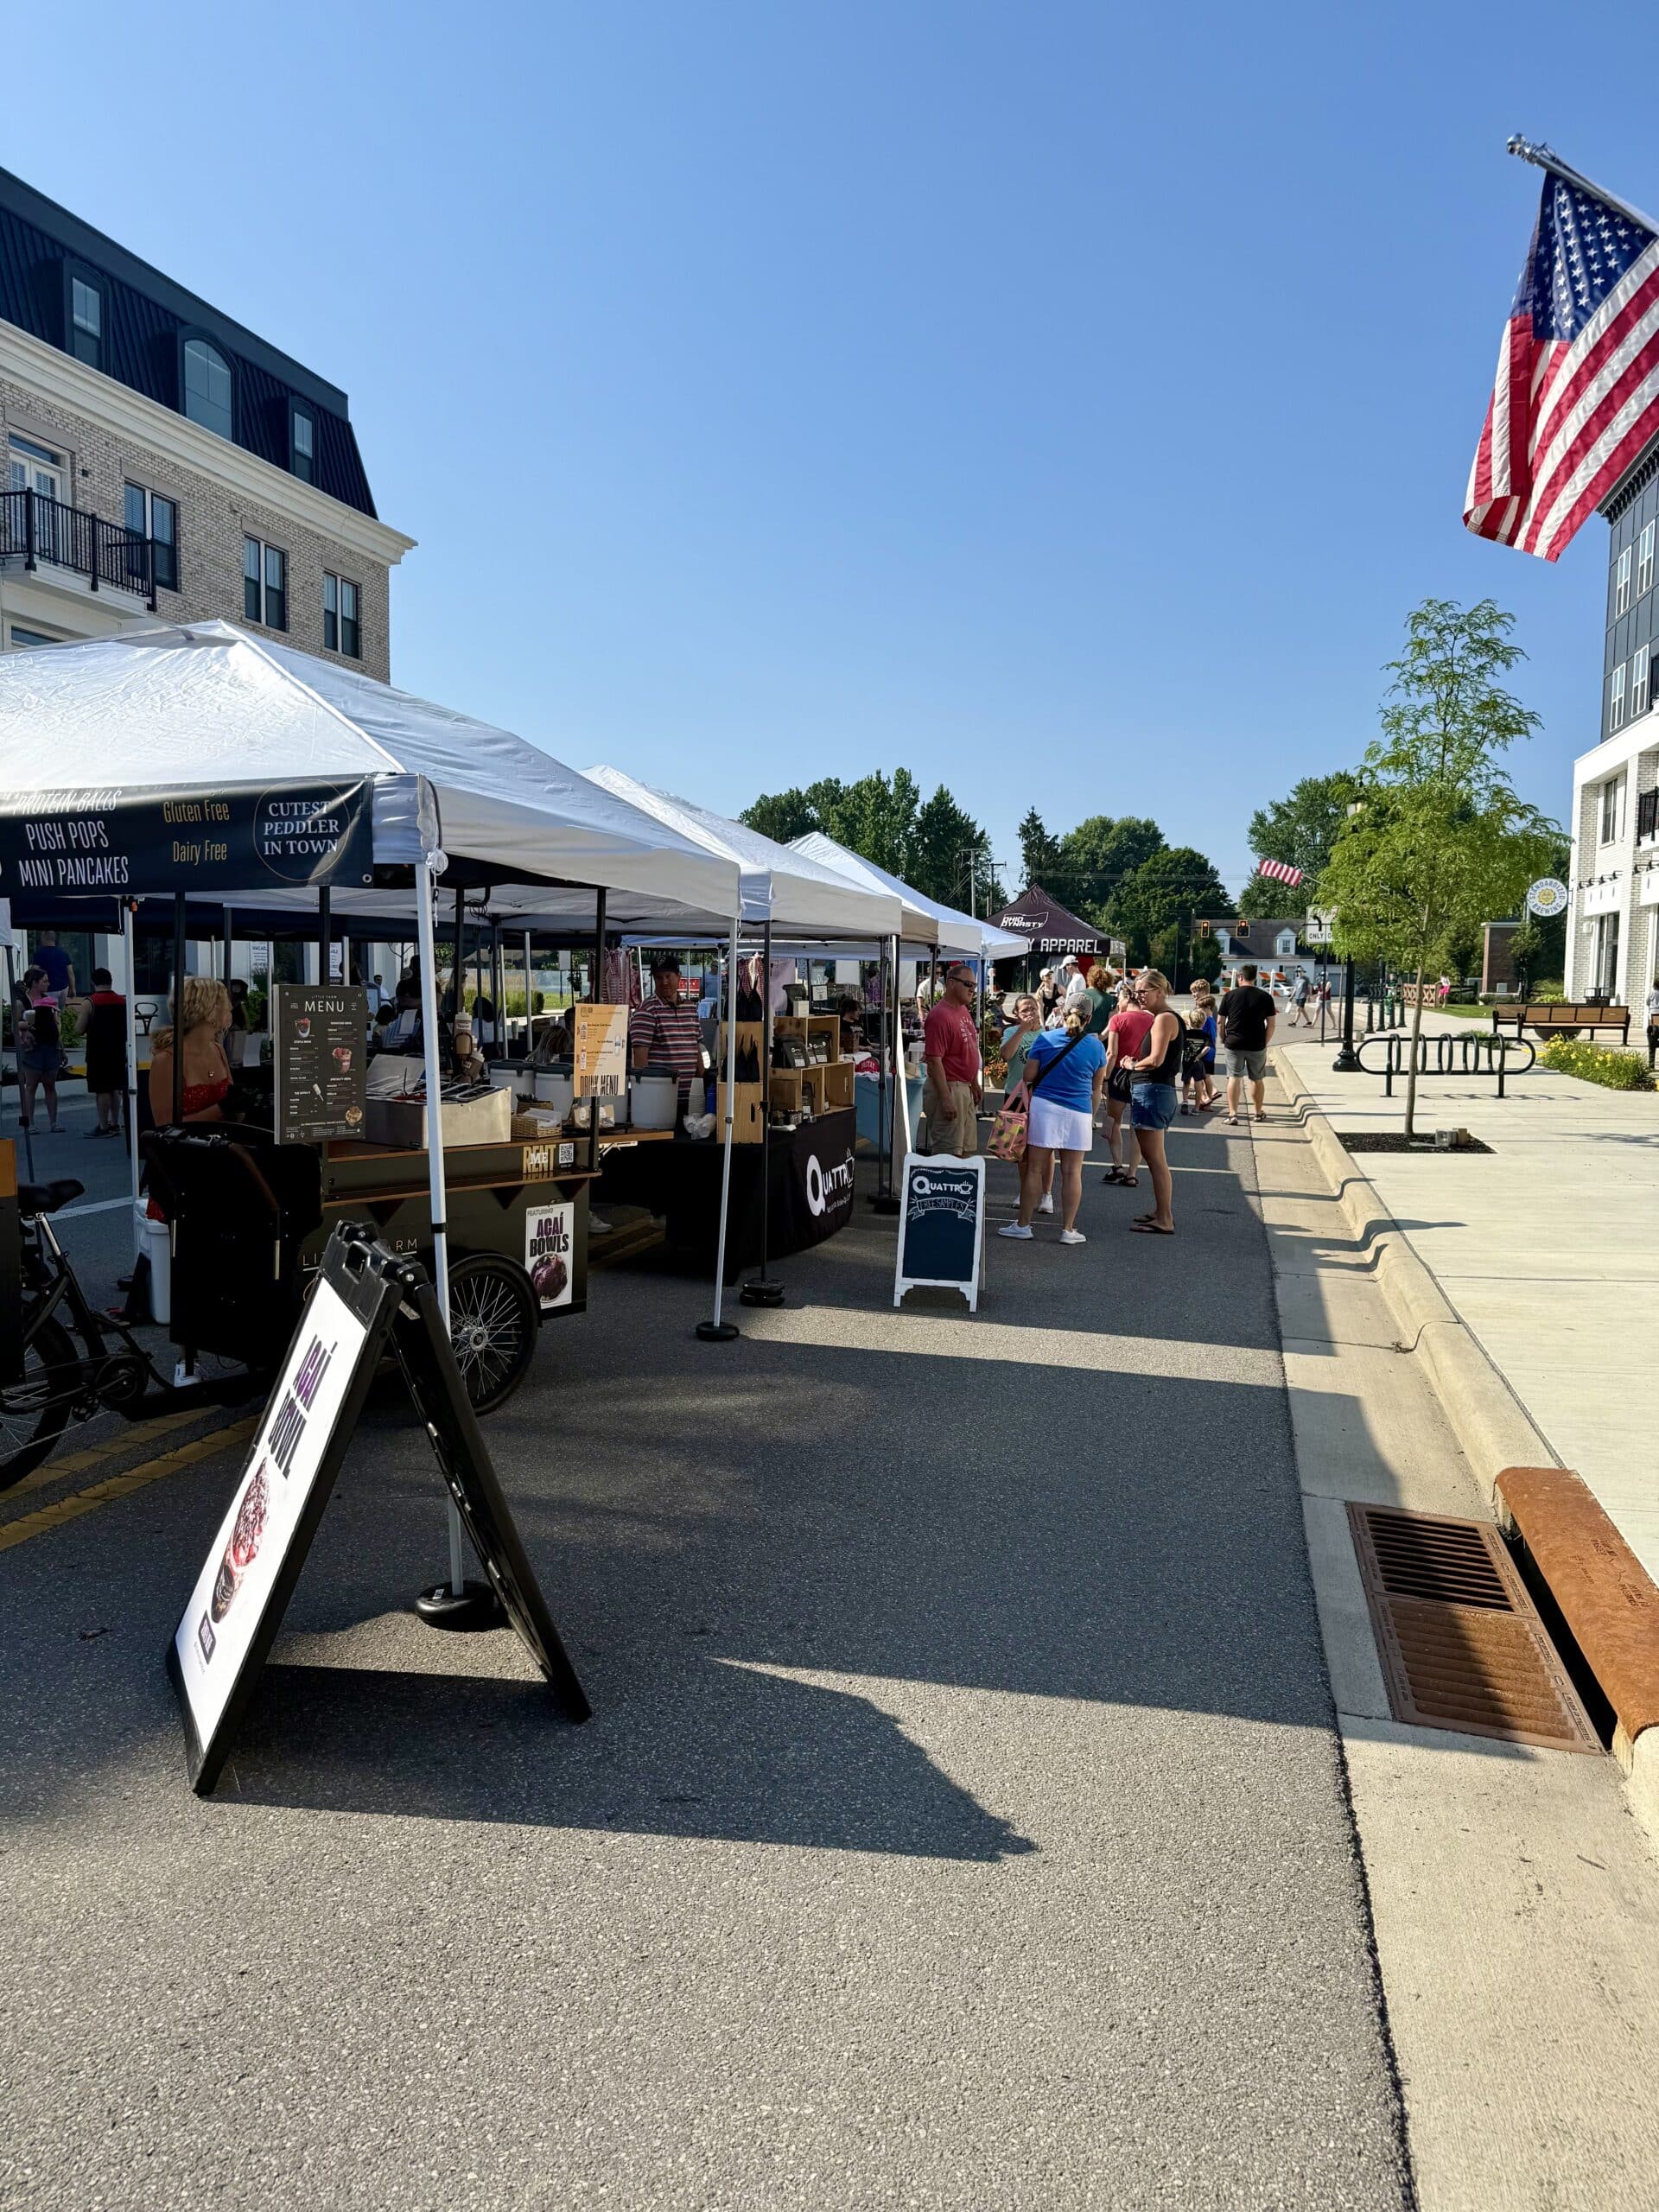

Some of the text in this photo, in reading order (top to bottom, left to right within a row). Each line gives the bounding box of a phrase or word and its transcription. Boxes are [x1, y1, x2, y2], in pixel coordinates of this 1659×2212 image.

[13, 793, 76, 816] PROTEIN
[76, 790, 122, 812] BALLS
[163, 799, 230, 823] Gluten Free
[269, 801, 332, 817] CUTEST
[25, 820, 109, 850] PUSH POPS
[264, 819, 340, 836] PEDDLER
[173, 839, 227, 866] Dairy Free
[264, 839, 338, 855] IN TOWN
[18, 855, 129, 887] MINI PANCAKES
[1529, 880, 1566, 899] STANDARDIZED
[1532, 902, 1562, 914] BREWING
[1040, 938, 1103, 954] APPAREL
[304, 1001, 345, 1013] MENU
[580, 1074, 619, 1097] DRINK MENU
[522, 1144, 556, 1173] RENT
[529, 1233, 569, 1258] BOWLS
